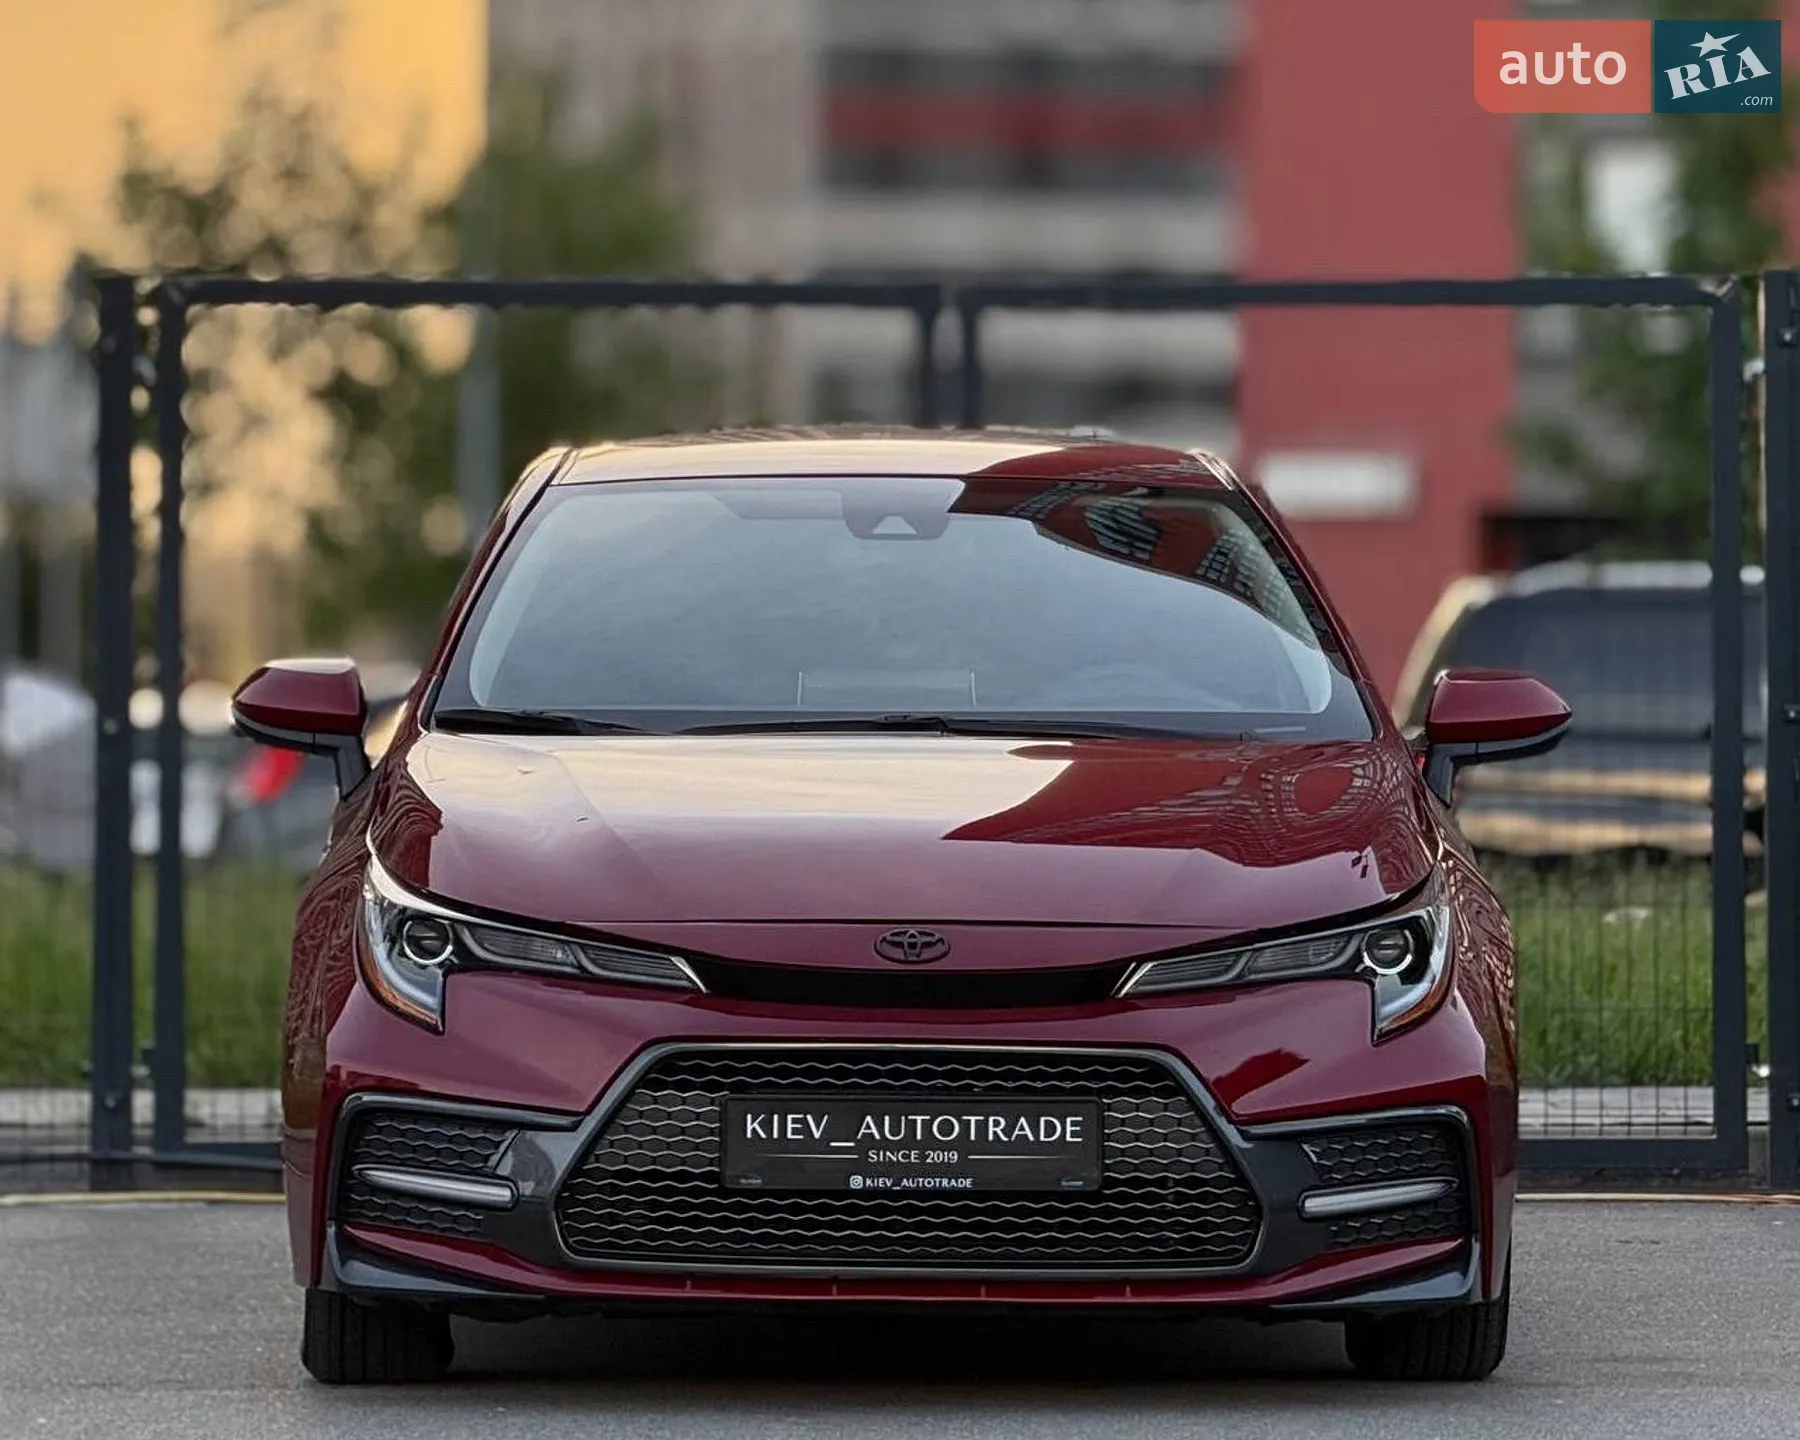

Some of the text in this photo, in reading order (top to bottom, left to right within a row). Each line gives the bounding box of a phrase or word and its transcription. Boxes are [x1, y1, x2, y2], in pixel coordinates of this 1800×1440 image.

[745, 1113, 1084, 1147] KIEV_AUTOTRADE
[867, 1149, 958, 1163] SINCE 2019
[865, 1177, 974, 1190] KIEV_AUTOTRADE
